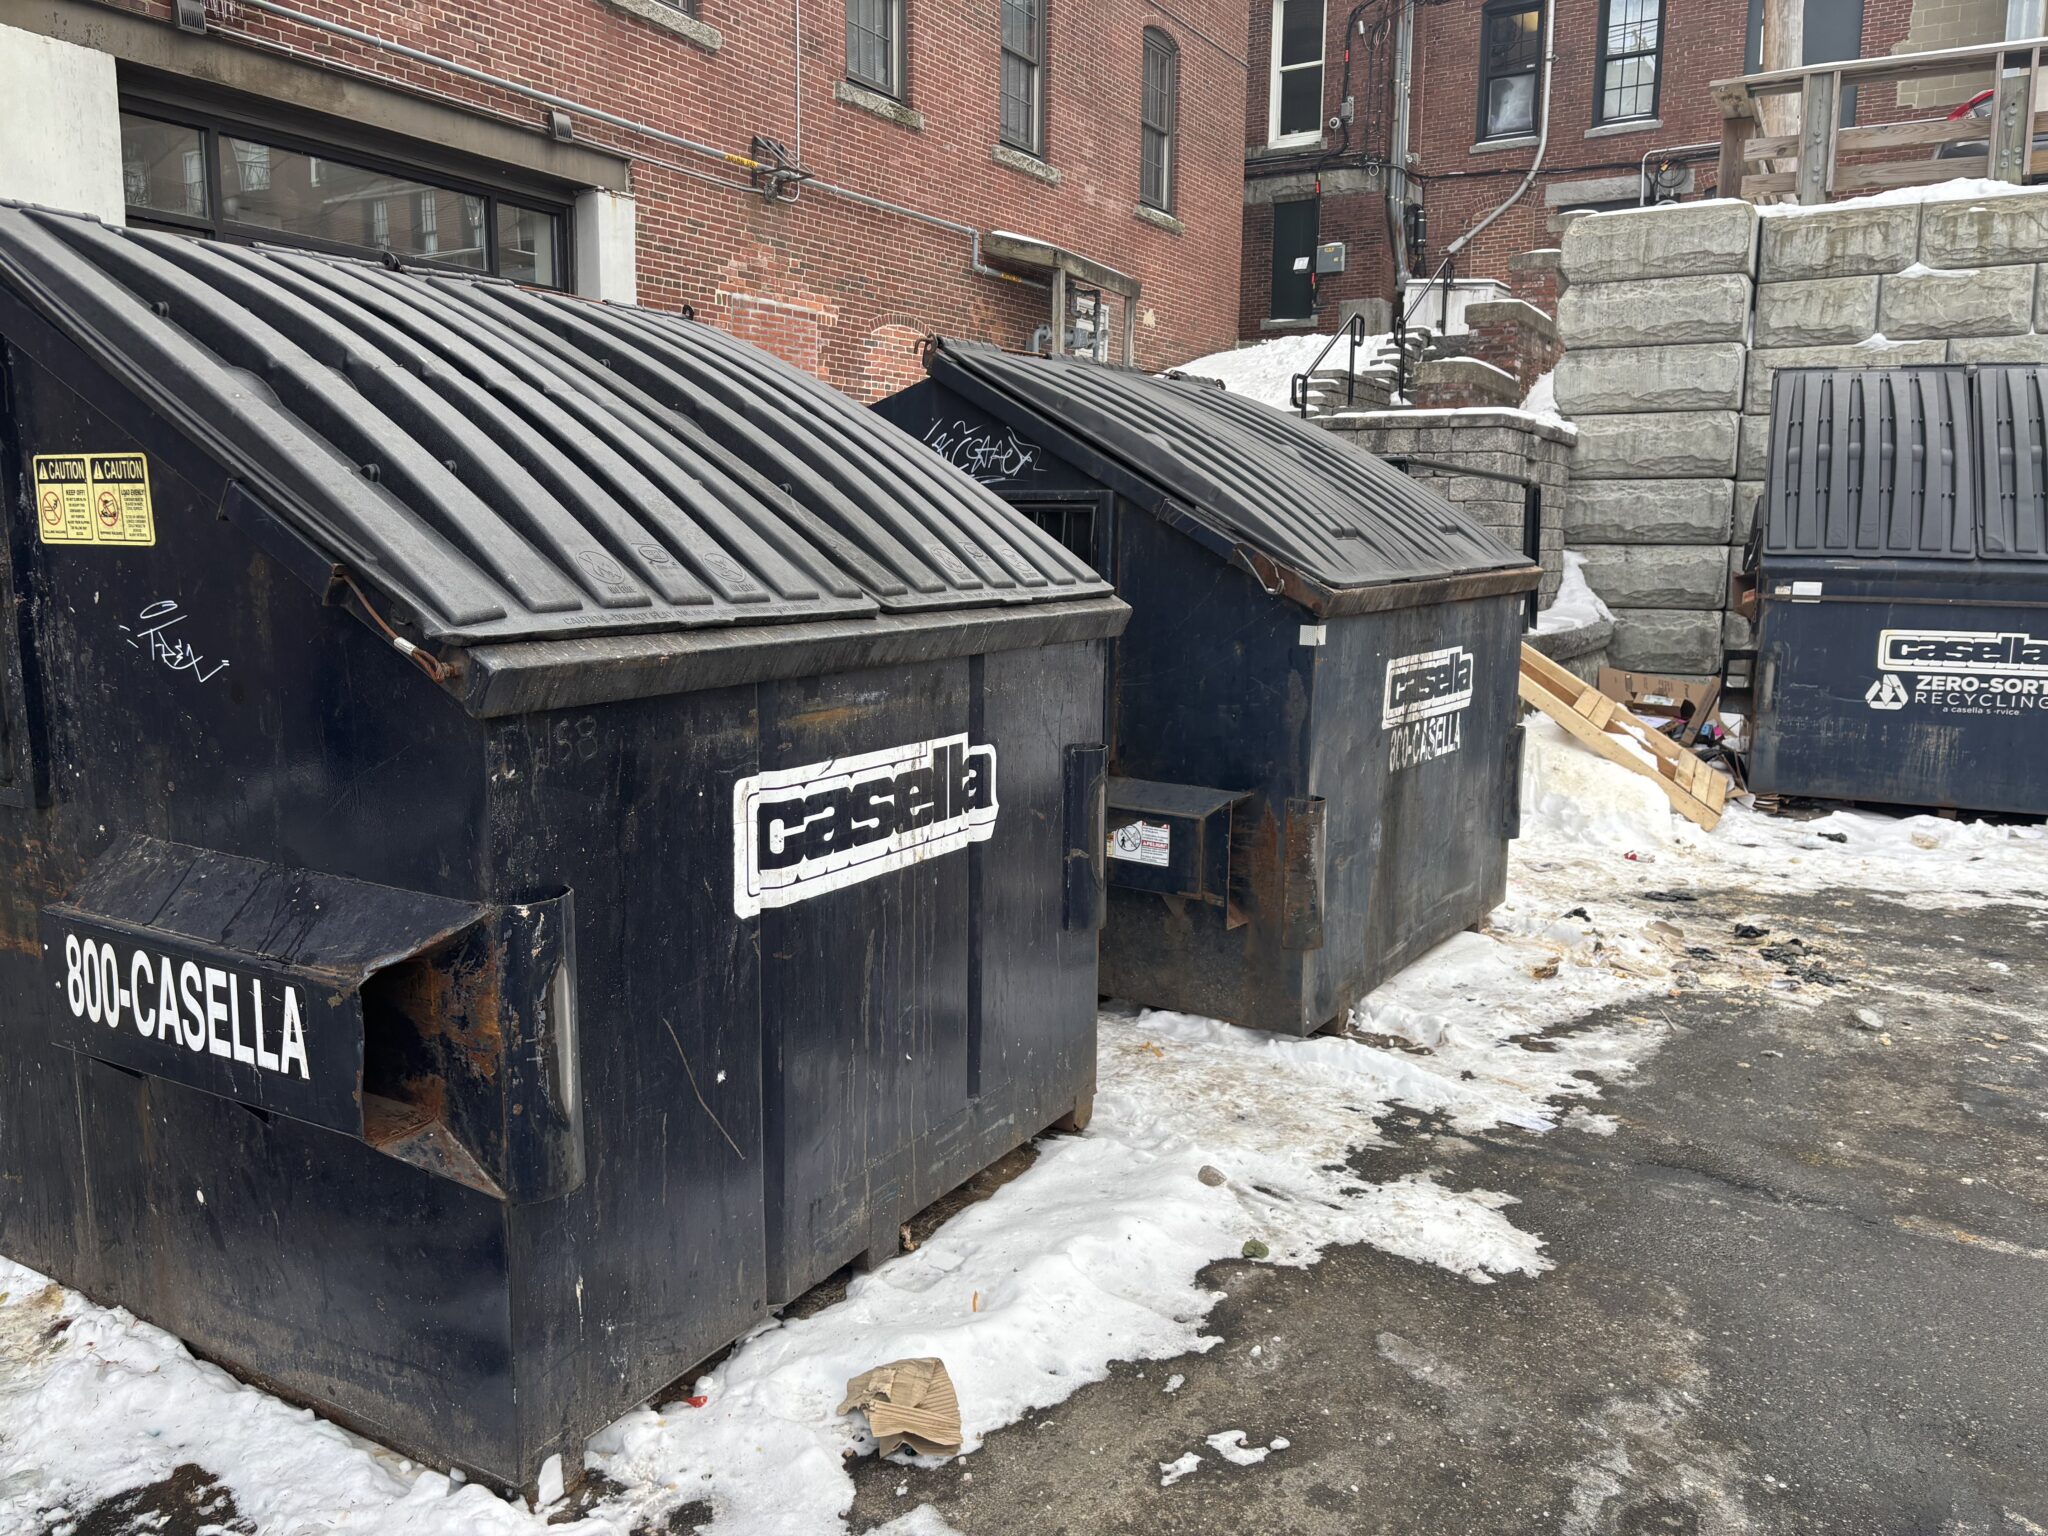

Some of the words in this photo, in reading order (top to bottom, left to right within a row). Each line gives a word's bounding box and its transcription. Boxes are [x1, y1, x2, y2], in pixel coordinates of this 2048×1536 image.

[48, 461, 85, 480] CAUTION
[103, 460, 143, 479] CAUTION
[1887, 635, 2048, 668] casella
[1388, 651, 1472, 711] casella
[1914, 691, 2048, 709] RECYCLING
[1950, 706, 1984, 714] casella
[752, 740, 995, 876] casella
[65, 933, 311, 1080] 800-CASELLA
